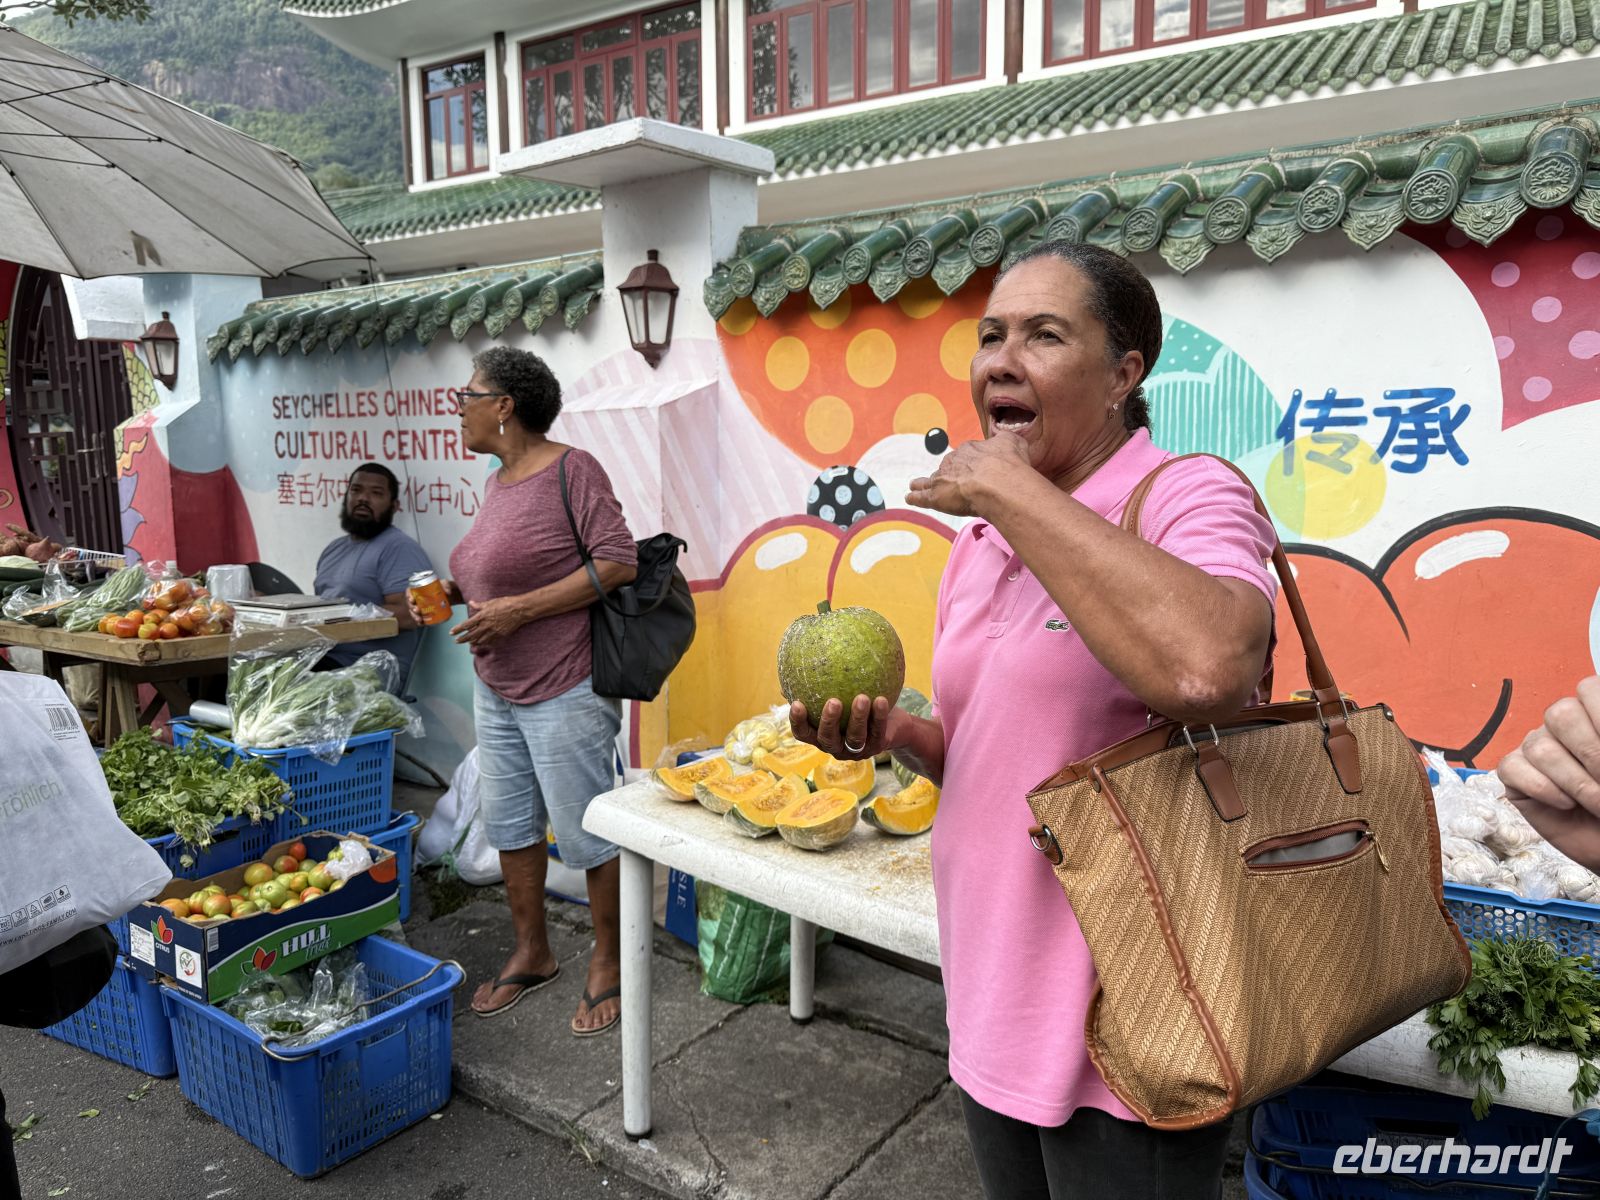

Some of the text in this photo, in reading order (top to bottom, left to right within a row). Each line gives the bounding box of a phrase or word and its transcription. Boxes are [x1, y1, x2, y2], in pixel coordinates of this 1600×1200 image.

[272, 390, 379, 419] SEYCHELLES
[274, 430, 375, 459] CULTURAL
[1275, 387, 1471, 476] 传承
[277, 471, 480, 516] 塞舌尔中化中心
[0, 779, 62, 817] röhlich
[282, 924, 331, 957] HILL
